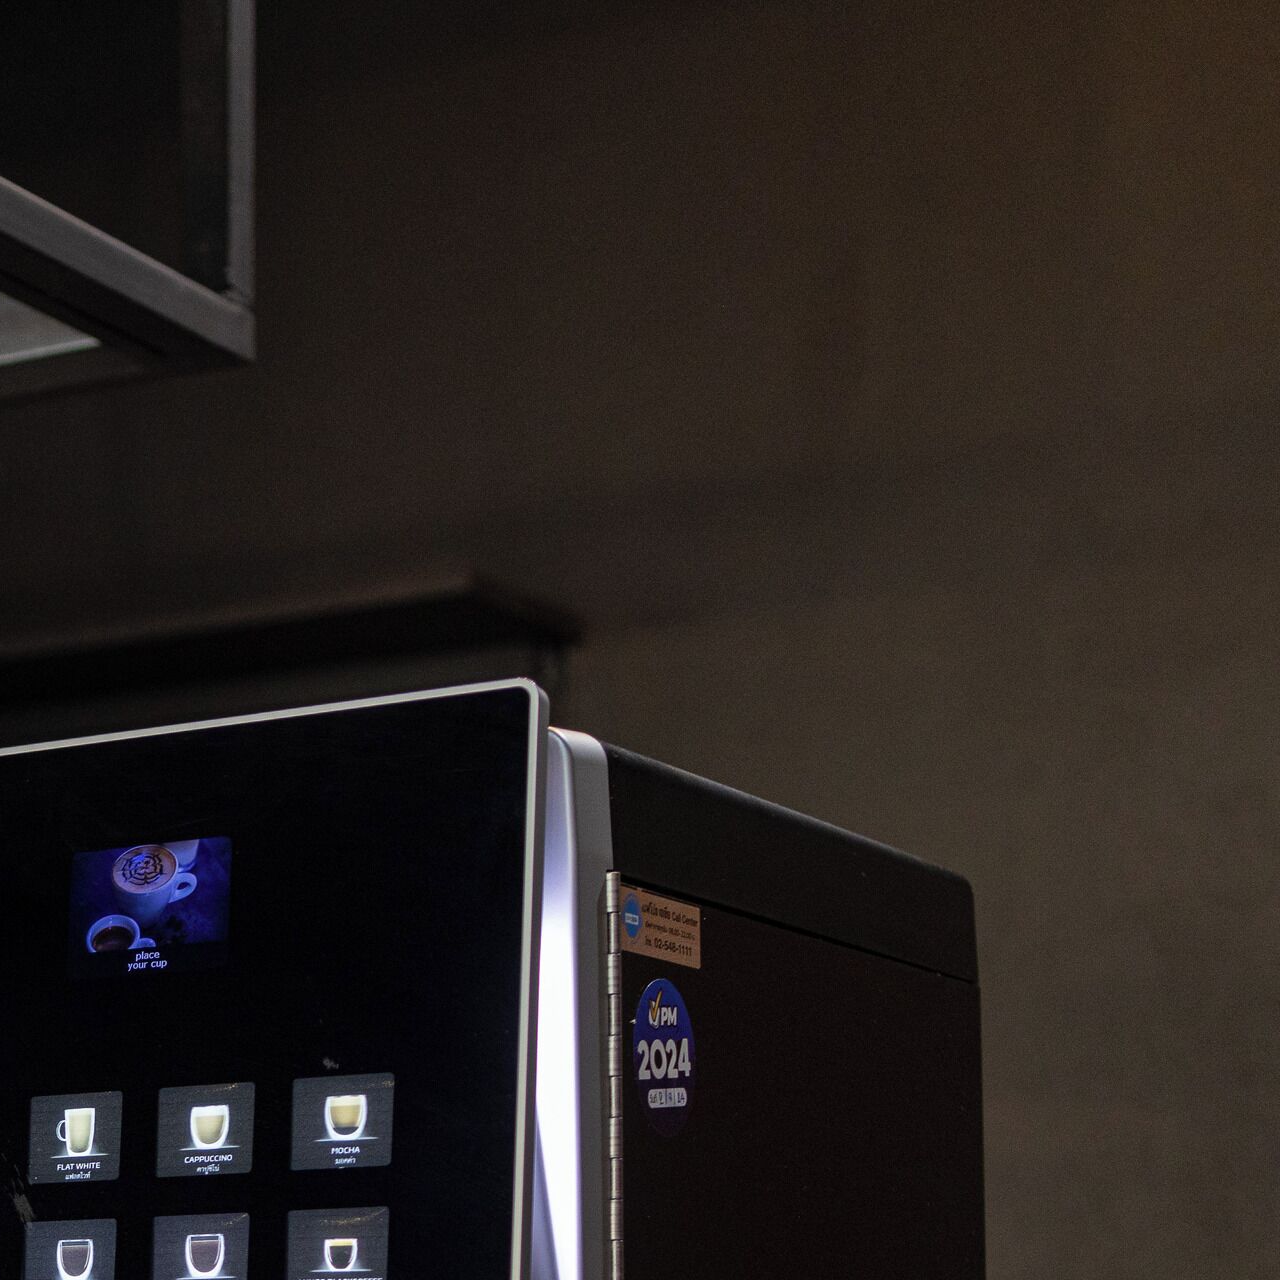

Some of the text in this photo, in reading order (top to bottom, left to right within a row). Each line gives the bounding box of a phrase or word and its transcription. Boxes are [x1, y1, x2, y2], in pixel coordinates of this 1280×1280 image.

[135, 951, 160, 962] place
[127, 959, 168, 971] your cup
[637, 1037, 691, 1080] 2024
[331, 1146, 361, 1155] MOCHA
[184, 1154, 233, 1164] CAPPUCCINO
[56, 1161, 101, 1171] FLAT WHITE
